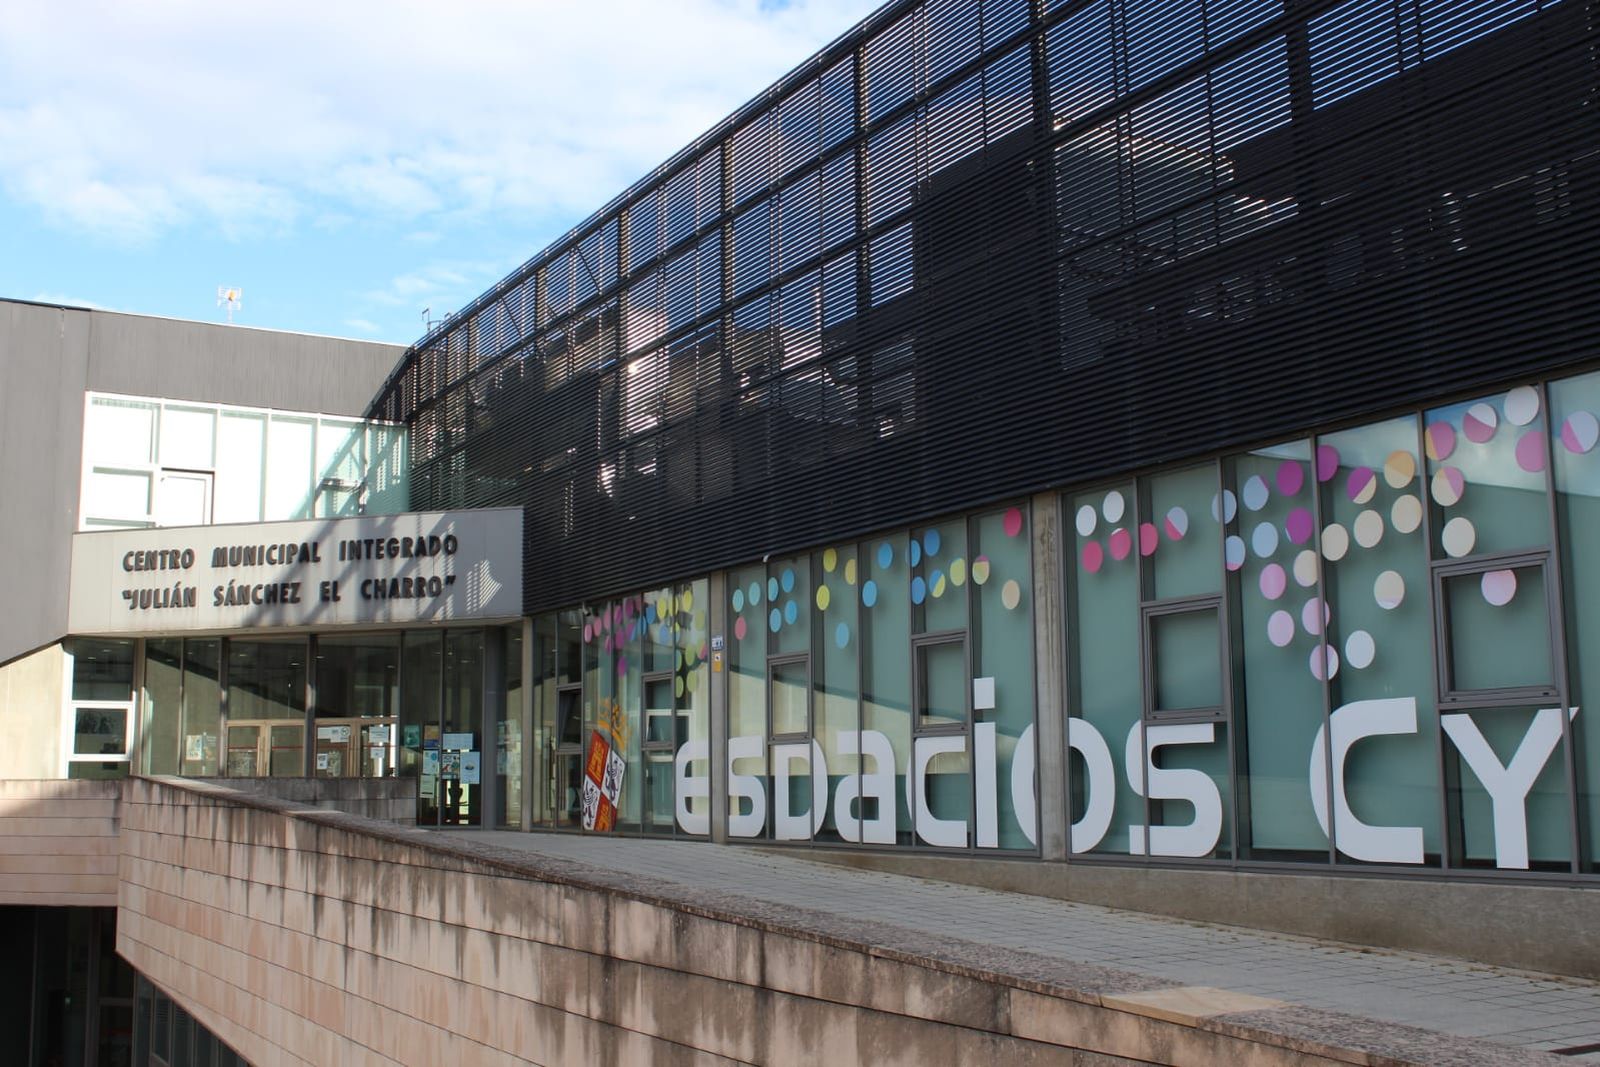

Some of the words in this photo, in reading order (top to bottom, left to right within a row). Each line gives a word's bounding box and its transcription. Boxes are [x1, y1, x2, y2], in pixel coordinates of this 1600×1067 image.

[122, 548, 196, 572] CENTRO
[211, 541, 321, 568] MUNICIPAL
[338, 534, 458, 562] INTEGRADO
[213, 579, 302, 607] SÁNCHEZ
[319, 580, 341, 602] EL
